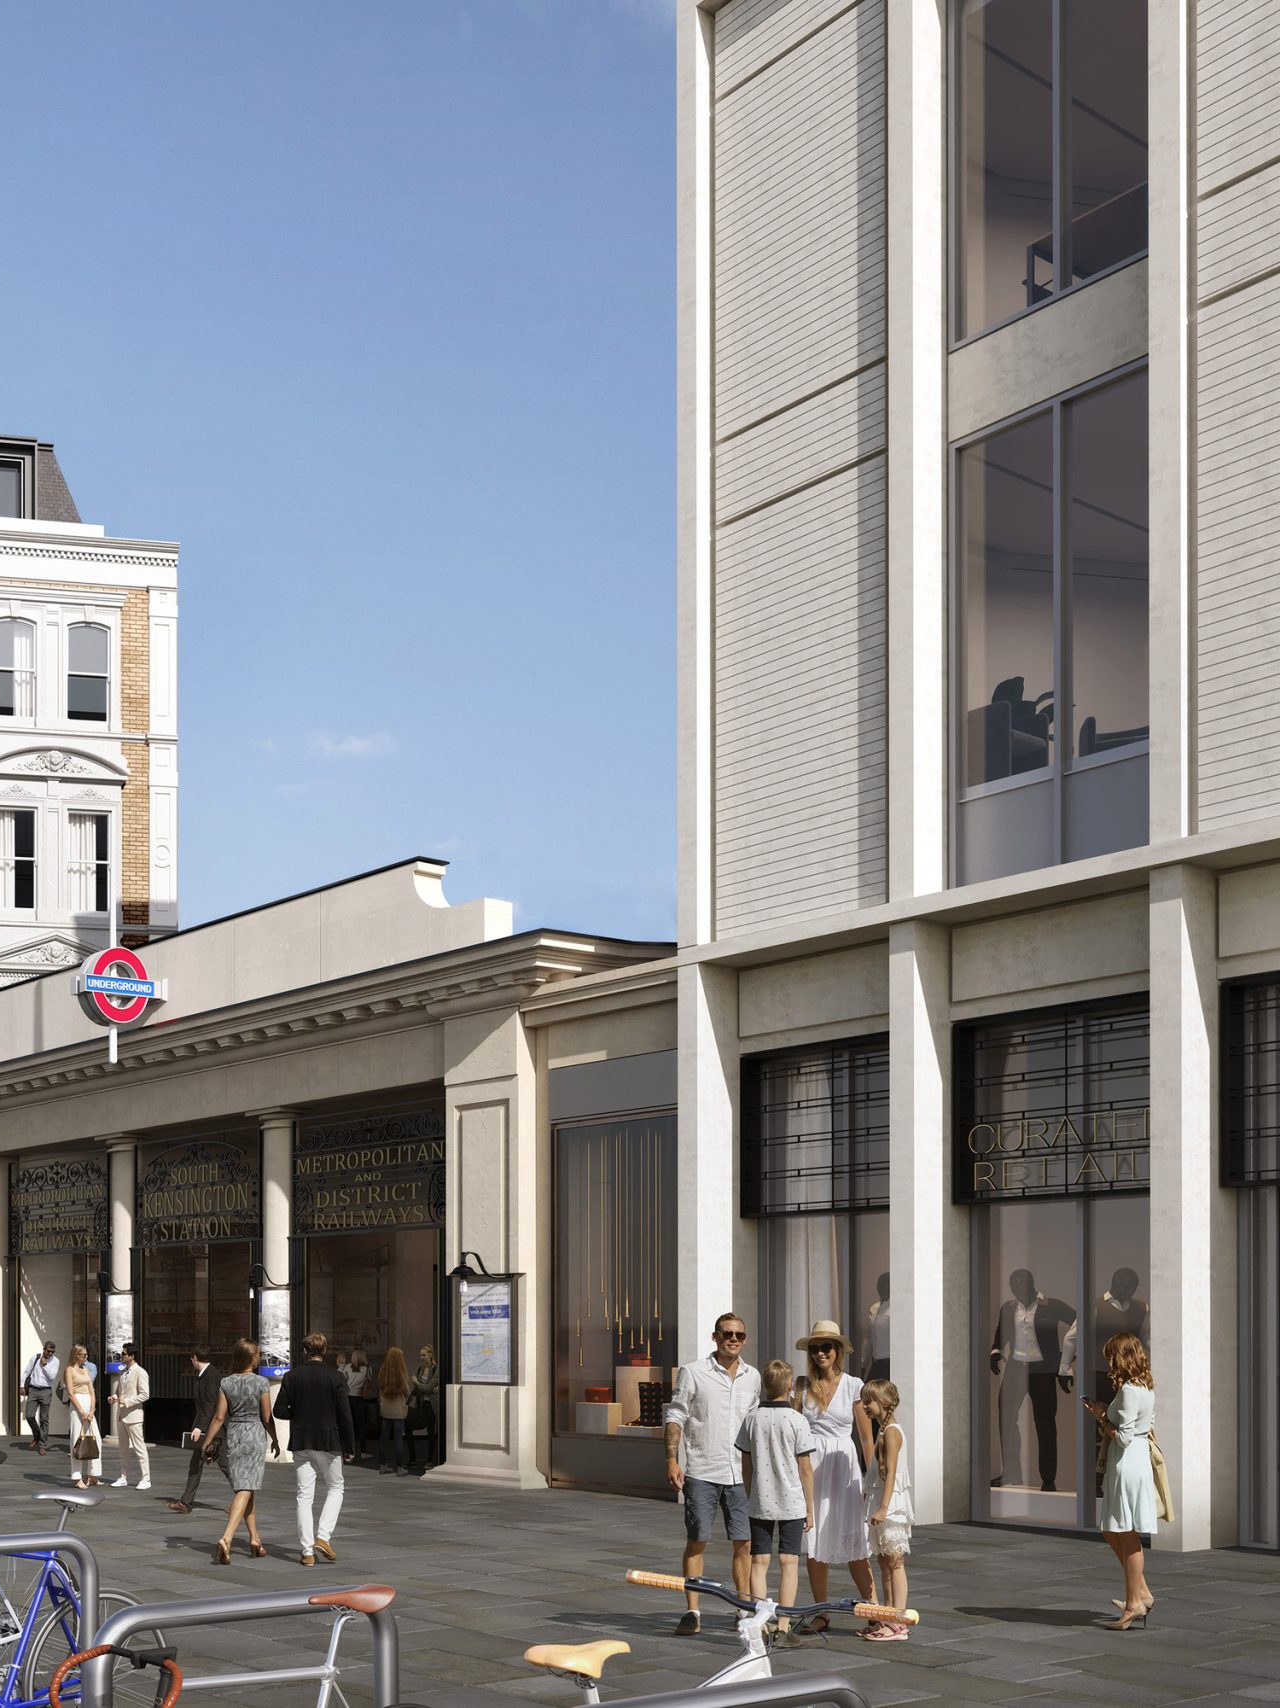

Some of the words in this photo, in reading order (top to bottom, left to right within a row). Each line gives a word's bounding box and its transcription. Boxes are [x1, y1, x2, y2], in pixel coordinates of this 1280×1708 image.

[87, 978, 152, 994] UNDERGROUND
[967, 1107, 1150, 1155] CURATE
[296, 1140, 445, 1175] METROPOLITAN
[170, 1163, 219, 1186] SOUTH
[353, 1171, 382, 1182] AND
[973, 1150, 1150, 1192] RETAIL
[11, 1184, 104, 1207] METROPOLITAN
[143, 1182, 249, 1218] KENSINGTON
[316, 1182, 422, 1208] DISTRICT
[25, 1215, 90, 1233] DISTRICT
[160, 1215, 232, 1242] STATION
[314, 1204, 424, 1231] RAILWAYS
[22, 1233, 91, 1251] RAILWAYS
